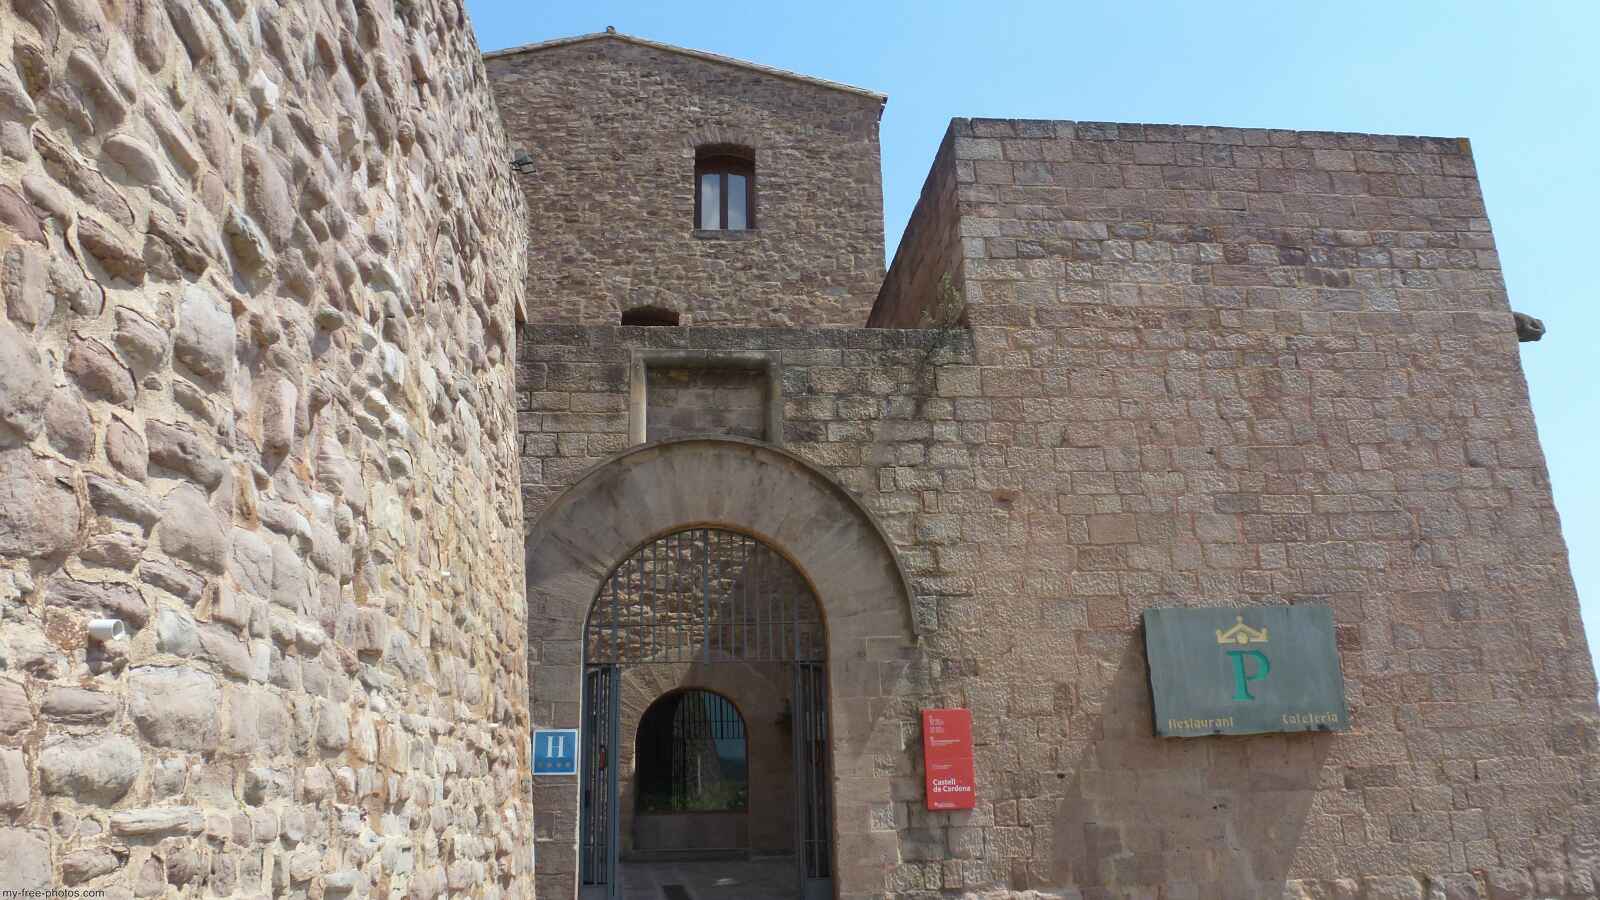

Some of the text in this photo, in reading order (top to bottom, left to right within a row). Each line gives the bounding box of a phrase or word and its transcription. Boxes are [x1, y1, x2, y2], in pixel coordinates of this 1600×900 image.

[1226, 650, 1270, 701] P
[1168, 716, 1234, 729] Restaurant
[545, 735, 566, 758] H
[932, 785, 942, 793] de
